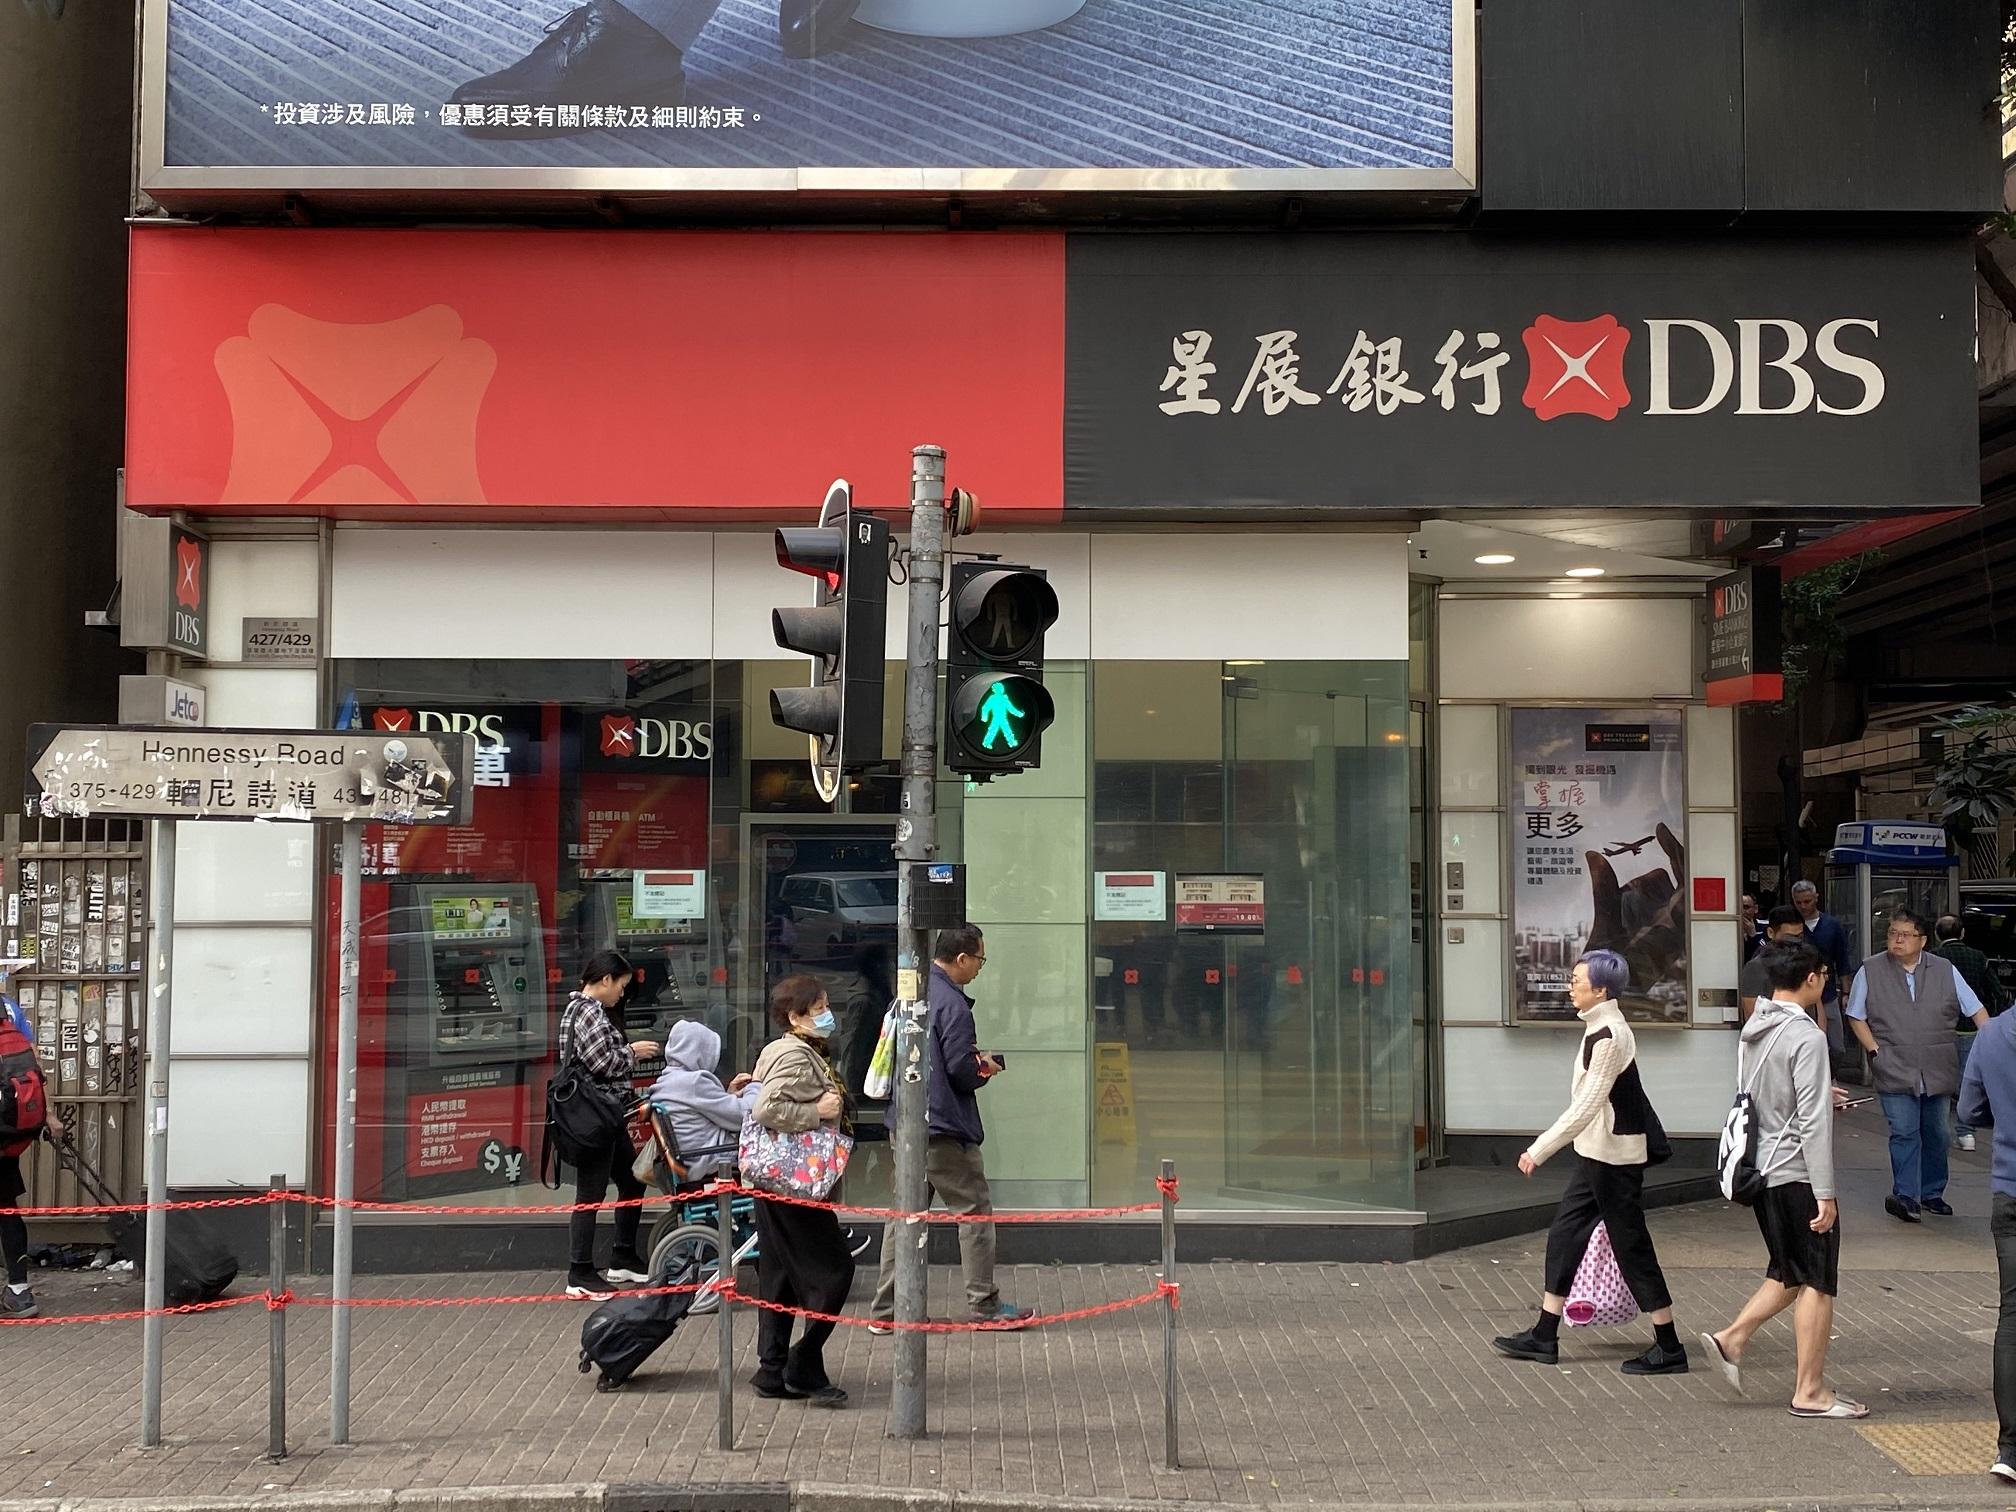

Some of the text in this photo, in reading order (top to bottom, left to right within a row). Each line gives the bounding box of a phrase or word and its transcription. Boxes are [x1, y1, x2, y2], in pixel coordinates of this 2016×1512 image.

[1158, 329, 1511, 417] 星展銀行
[1643, 318, 1886, 417] DBS
[1725, 581, 1747, 615] DBS
[175, 611, 200, 646] DBS
[249, 633, 312, 646] 427/429
[638, 717, 713, 761] DBS
[142, 740, 345, 767] Hennessy Road
[69, 782, 156, 799] 375-429
[638, 813, 656, 822] ATM
[1524, 811, 1584, 840] 更多
[1892, 832, 1919, 840] PCCW
[422, 1098, 467, 1114] 人民幣提取
[435, 1111, 467, 1121] withdrawal
[420, 1144, 457, 1159] 支票存入
[420, 1155, 463, 1168] Cheque deposit
